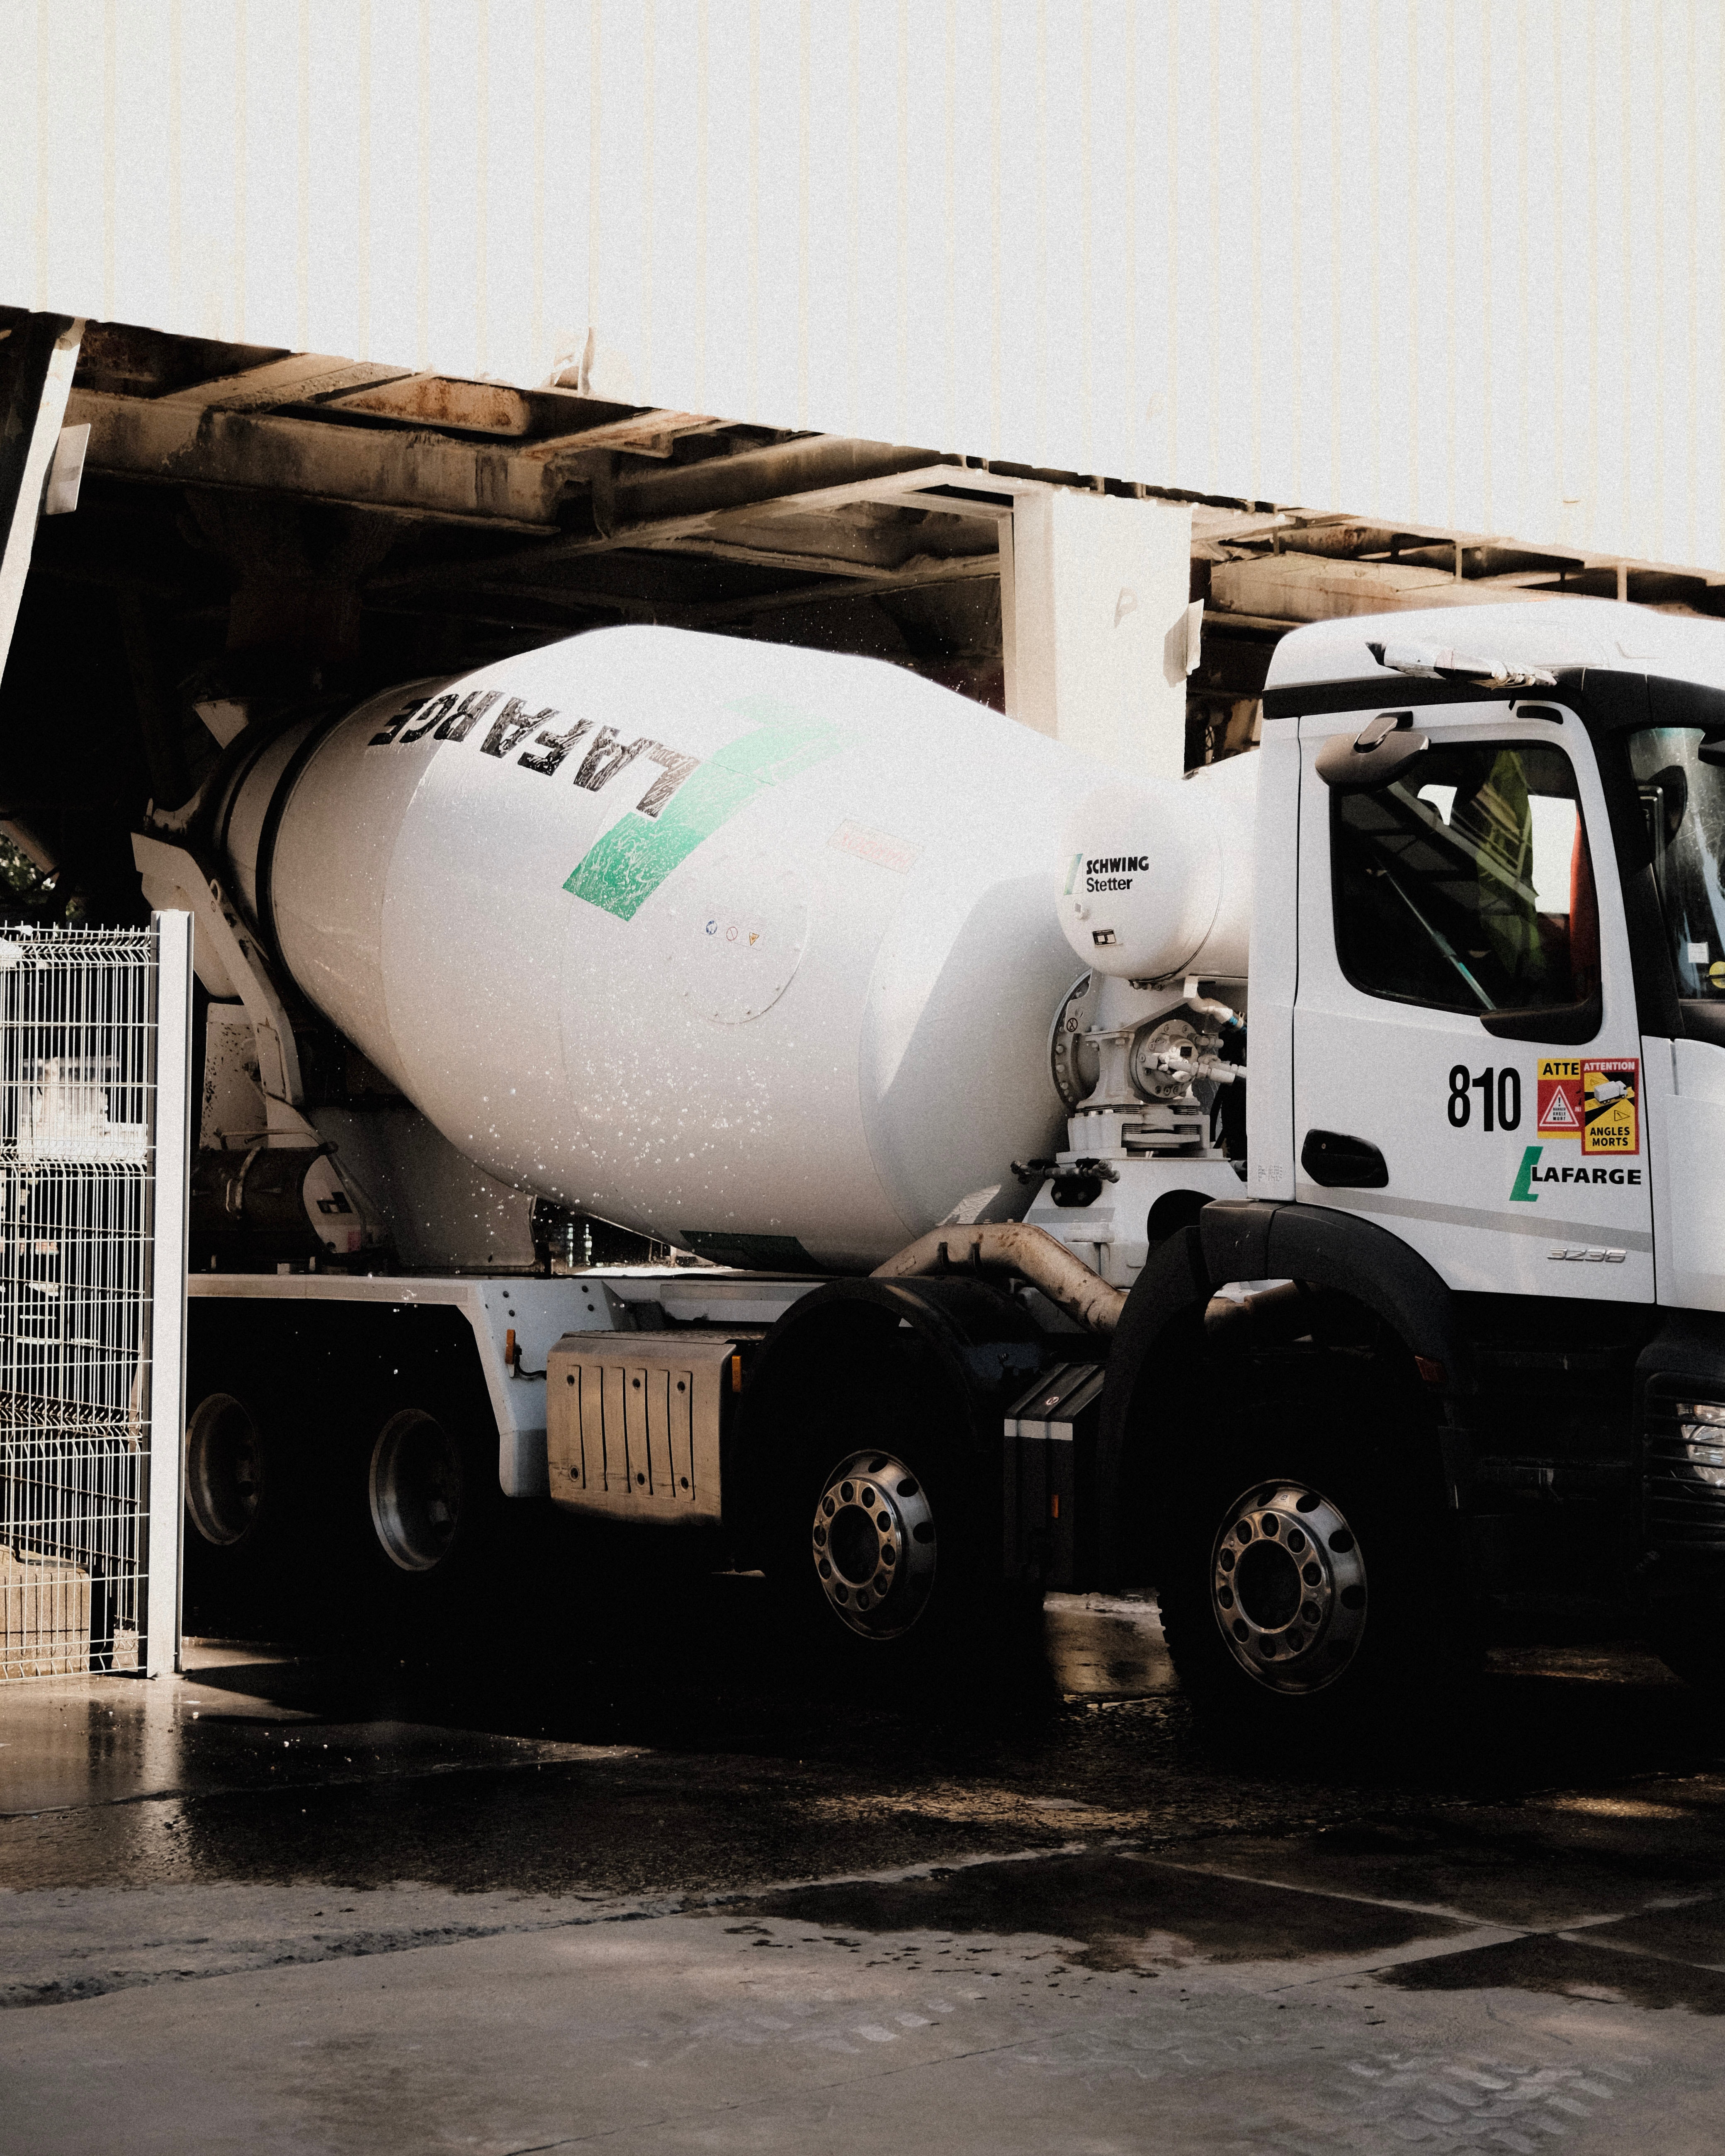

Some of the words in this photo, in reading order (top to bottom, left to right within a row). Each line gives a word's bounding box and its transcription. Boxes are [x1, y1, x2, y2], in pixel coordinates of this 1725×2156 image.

[368, 690, 700, 818] LAFARGE
[1086, 856, 1149, 874] SCHWING
[1086, 877, 1133, 892] Stetter
[1584, 1061, 1635, 1071] ATTENTION
[1448, 1065, 1521, 1132] 810
[1590, 1127, 1630, 1136] ANGLES
[1592, 1137, 1628, 1146] MORTS
[1532, 1167, 1642, 1185] LAFARGE
[1547, 1247, 1627, 1263] 3236
